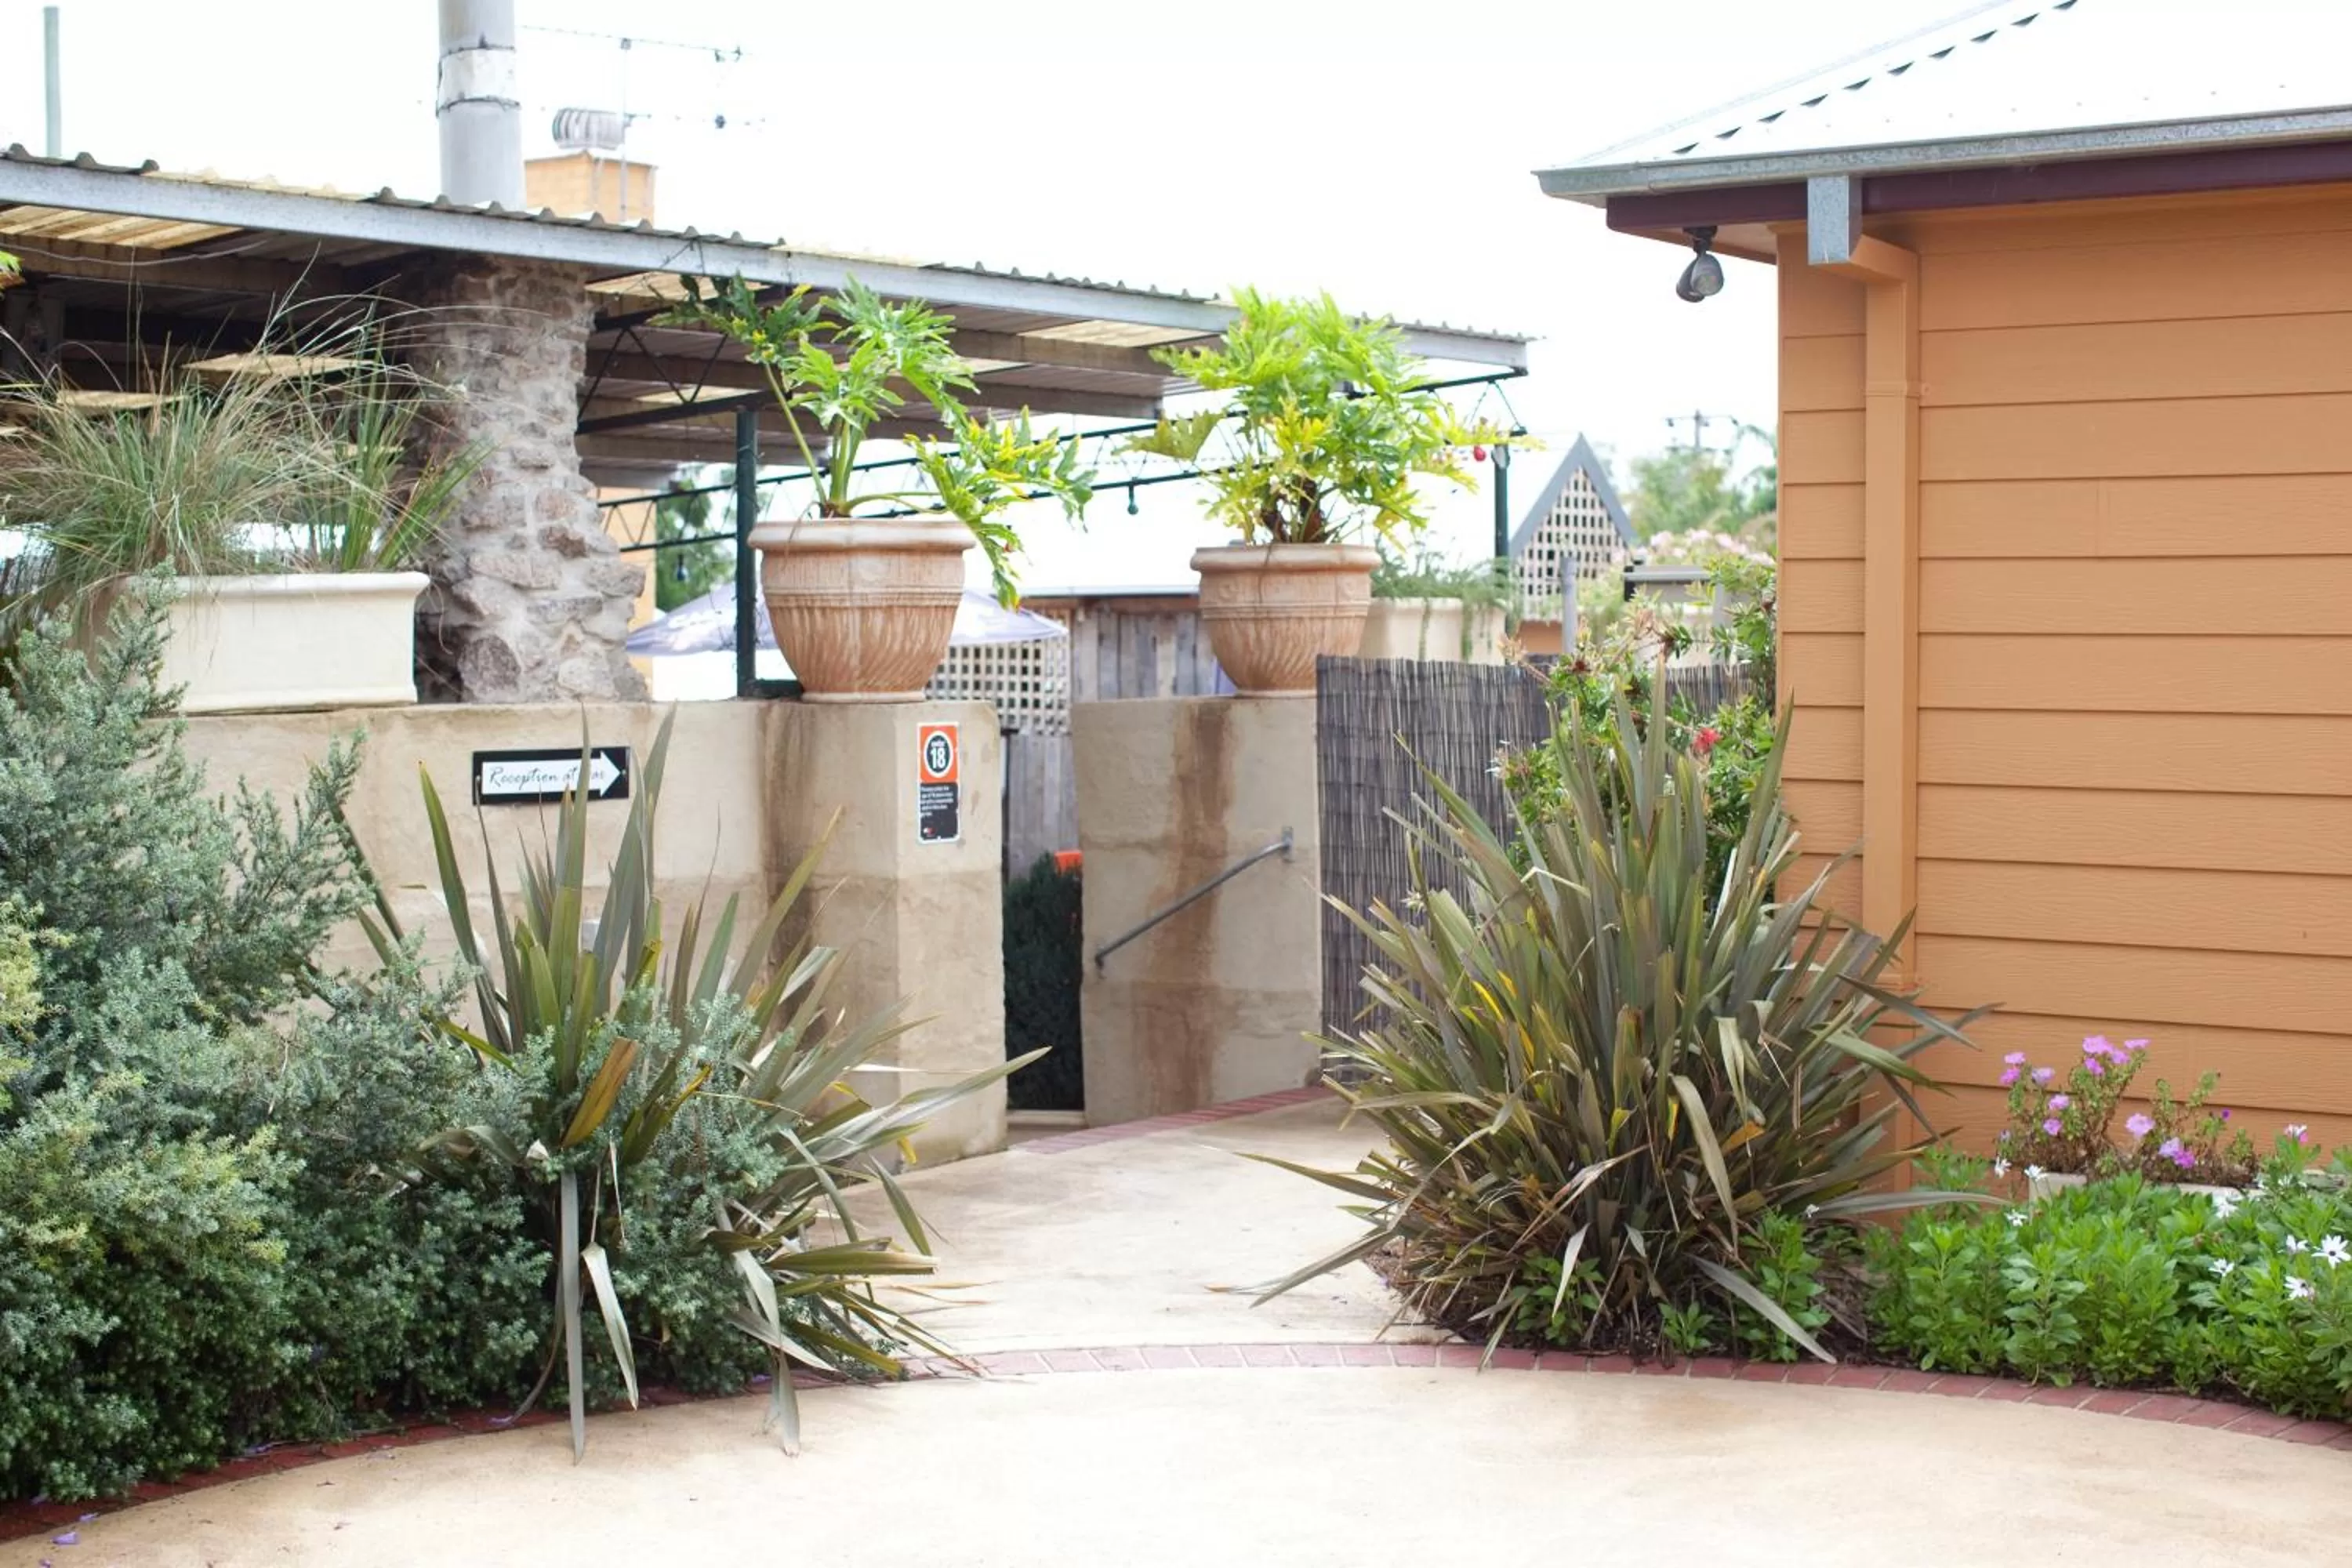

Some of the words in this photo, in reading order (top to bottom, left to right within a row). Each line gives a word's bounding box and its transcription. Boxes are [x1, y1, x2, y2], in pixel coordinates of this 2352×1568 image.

[931, 748, 946, 768] 18
[488, 766, 557, 790] Reception
[562, 765, 579, 782] at
